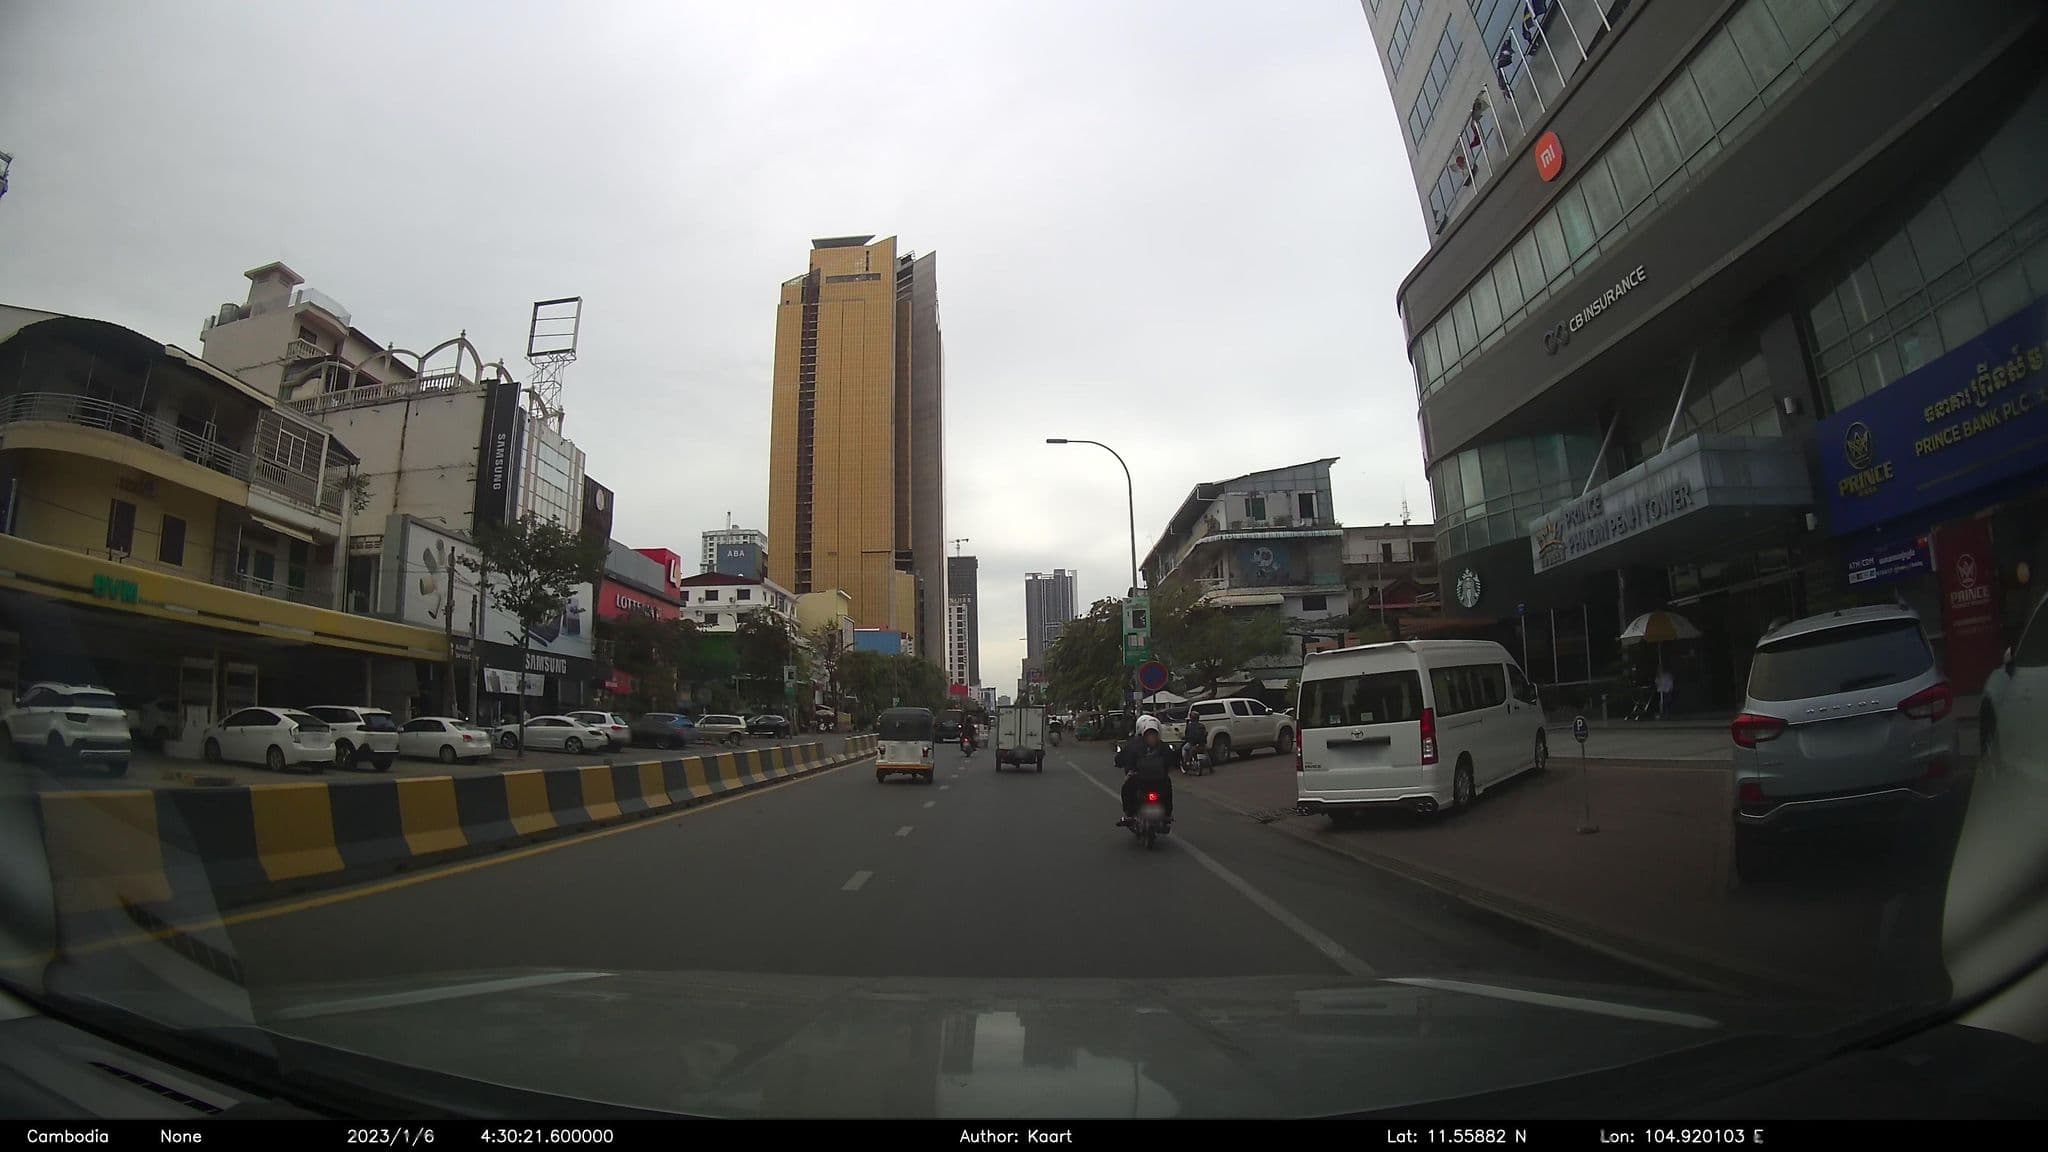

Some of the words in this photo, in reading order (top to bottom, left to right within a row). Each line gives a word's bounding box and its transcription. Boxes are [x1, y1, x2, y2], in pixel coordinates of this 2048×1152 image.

[1569, 313, 1584, 332] CB
[1583, 264, 1647, 322] INSURANCE
[1914, 424, 1961, 457] PRINCE
[1962, 408, 2001, 439] BANK
[493, 433, 506, 490] SAMSUNG
[1838, 461, 1895, 496] PRINCE
[1564, 496, 1602, 525] PRINCE
[1568, 519, 1610, 554] PHNOM
[1610, 505, 1641, 538] PENH
[1644, 484, 1694, 524] TOWER
[1951, 585, 1990, 602] PRINCE
[525, 653, 566, 674] SAMSUNG
[1576, 719, 1583, 731] P
